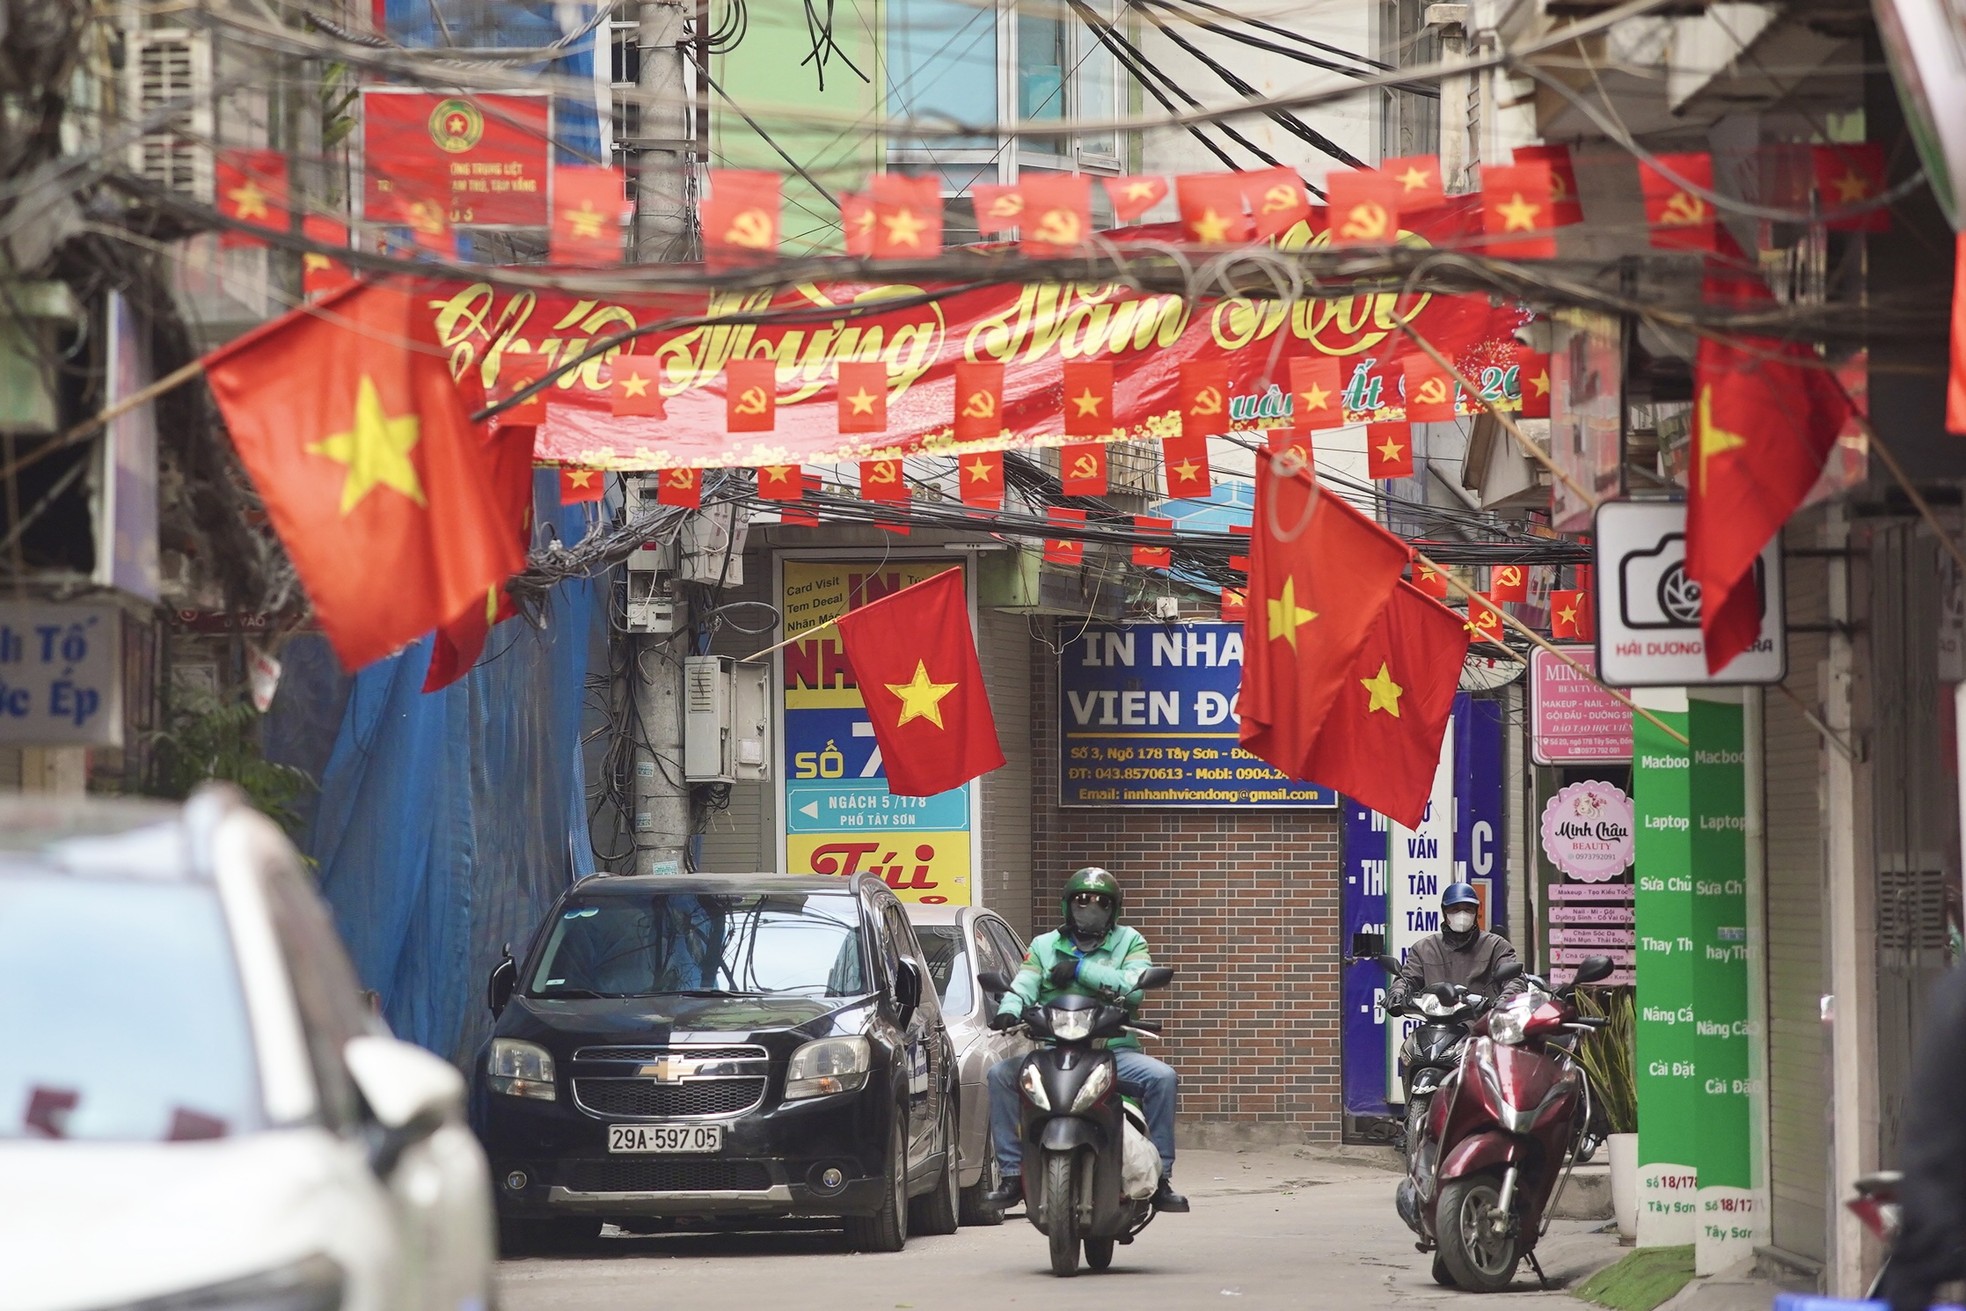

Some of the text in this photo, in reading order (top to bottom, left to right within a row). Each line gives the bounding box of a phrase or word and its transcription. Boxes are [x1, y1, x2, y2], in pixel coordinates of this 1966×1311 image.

[787, 577, 839, 596] Card Visit
[848, 573, 900, 611] IN
[787, 593, 843, 614] Tem Decal
[787, 618, 815, 632] Nhãn
[1082, 632, 1134, 666] IN
[1558, 685, 1591, 693] BEAUTY
[1542, 700, 1577, 708] MAKEUP
[1584, 700, 1603, 708] NAIL
[795, 739, 843, 778] SỐ
[1071, 746, 1087, 759] Số
[1091, 748, 1103, 761] 3,
[1138, 748, 1162, 759] 178
[1166, 747, 1190, 761] Tây
[1193, 747, 1218, 760] Sơn
[1642, 755, 1690, 768] Macboo
[1069, 768, 1091, 780] ĐT:
[1096, 768, 1183, 780] 043.8570613
[829, 793, 877, 809] NGÁCH
[882, 796, 890, 808] 5
[1080, 788, 1319, 802] Email: innhanhviendong@gmail.com
[840, 812, 916, 826] PHỐ TÂY SƠN
[1645, 814, 1690, 831] Laptop
[1555, 821, 1628, 843] Minh Châu
[1408, 831, 1437, 859] VẤN
[810, 843, 939, 890] Túi
[1408, 870, 1437, 899] TẬN
[1640, 876, 1664, 891] Sửa
[1406, 907, 1438, 931] TÂM
[1641, 937, 1693, 955] Thay Th
[1643, 1006, 1675, 1025] Nâng
[1696, 1021, 1729, 1038] Nâng
[1649, 1060, 1696, 1078] Cài Đặt
[1705, 1078, 1727, 1094] Cài
[1661, 1176, 1697, 1190] 18/17
[1648, 1201, 1696, 1214] Tây Sơn
[1705, 1225, 1727, 1241] Tây
